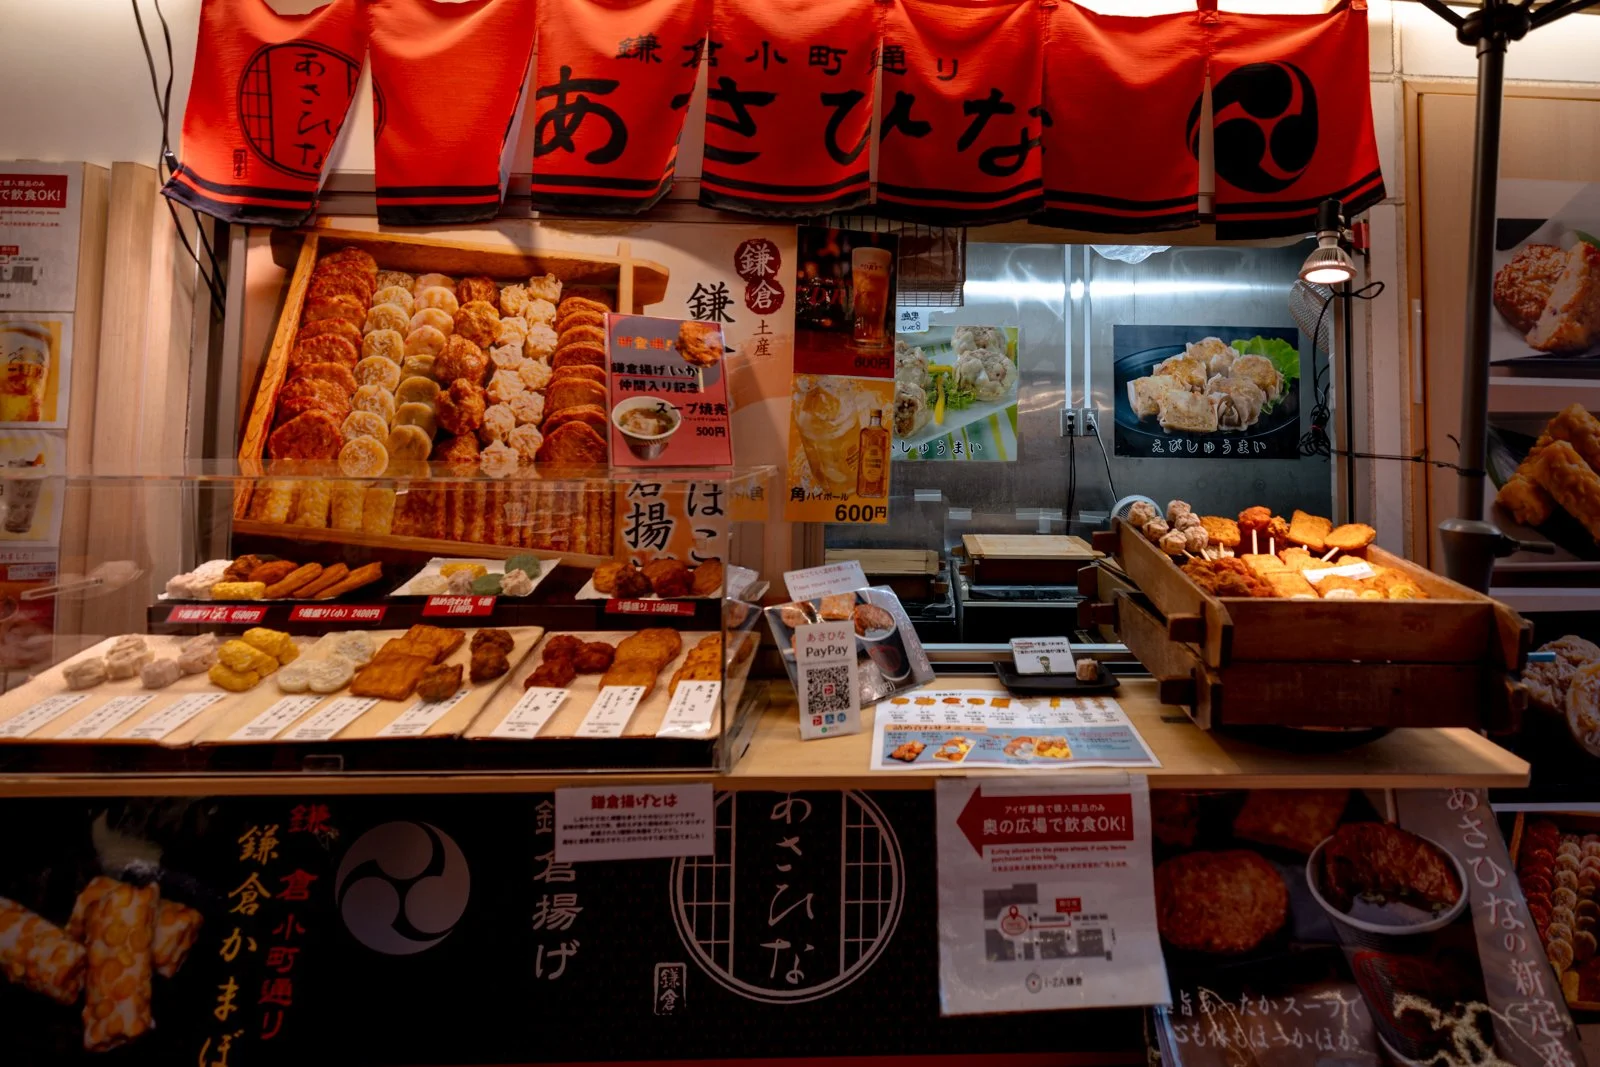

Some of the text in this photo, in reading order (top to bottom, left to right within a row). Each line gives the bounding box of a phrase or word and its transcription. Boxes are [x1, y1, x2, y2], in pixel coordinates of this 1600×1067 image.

[534, 65, 1053, 177] あさひな
[739, 243, 781, 357] 鎌倉 土産
[619, 380, 699, 393] 仲間入り記念
[656, 402, 728, 415] スープ焼売
[696, 426, 726, 437] 500円
[891, 440, 983, 455] しゅうまい
[1152, 439, 1267, 455] えびしゅうまい
[790, 487, 848, 501] 角ハイボール
[835, 504, 887, 522] 600円
[807, 630, 846, 642] あさひな
[806, 645, 848, 658] PayPay
[591, 794, 677, 810] 鎌倉揚げとは
[983, 816, 1126, 836] 奥の広場で飲食OK!
[258, 804, 331, 1040] 鎌倉小町通り
[660, 968, 680, 1010] 鎌倉
